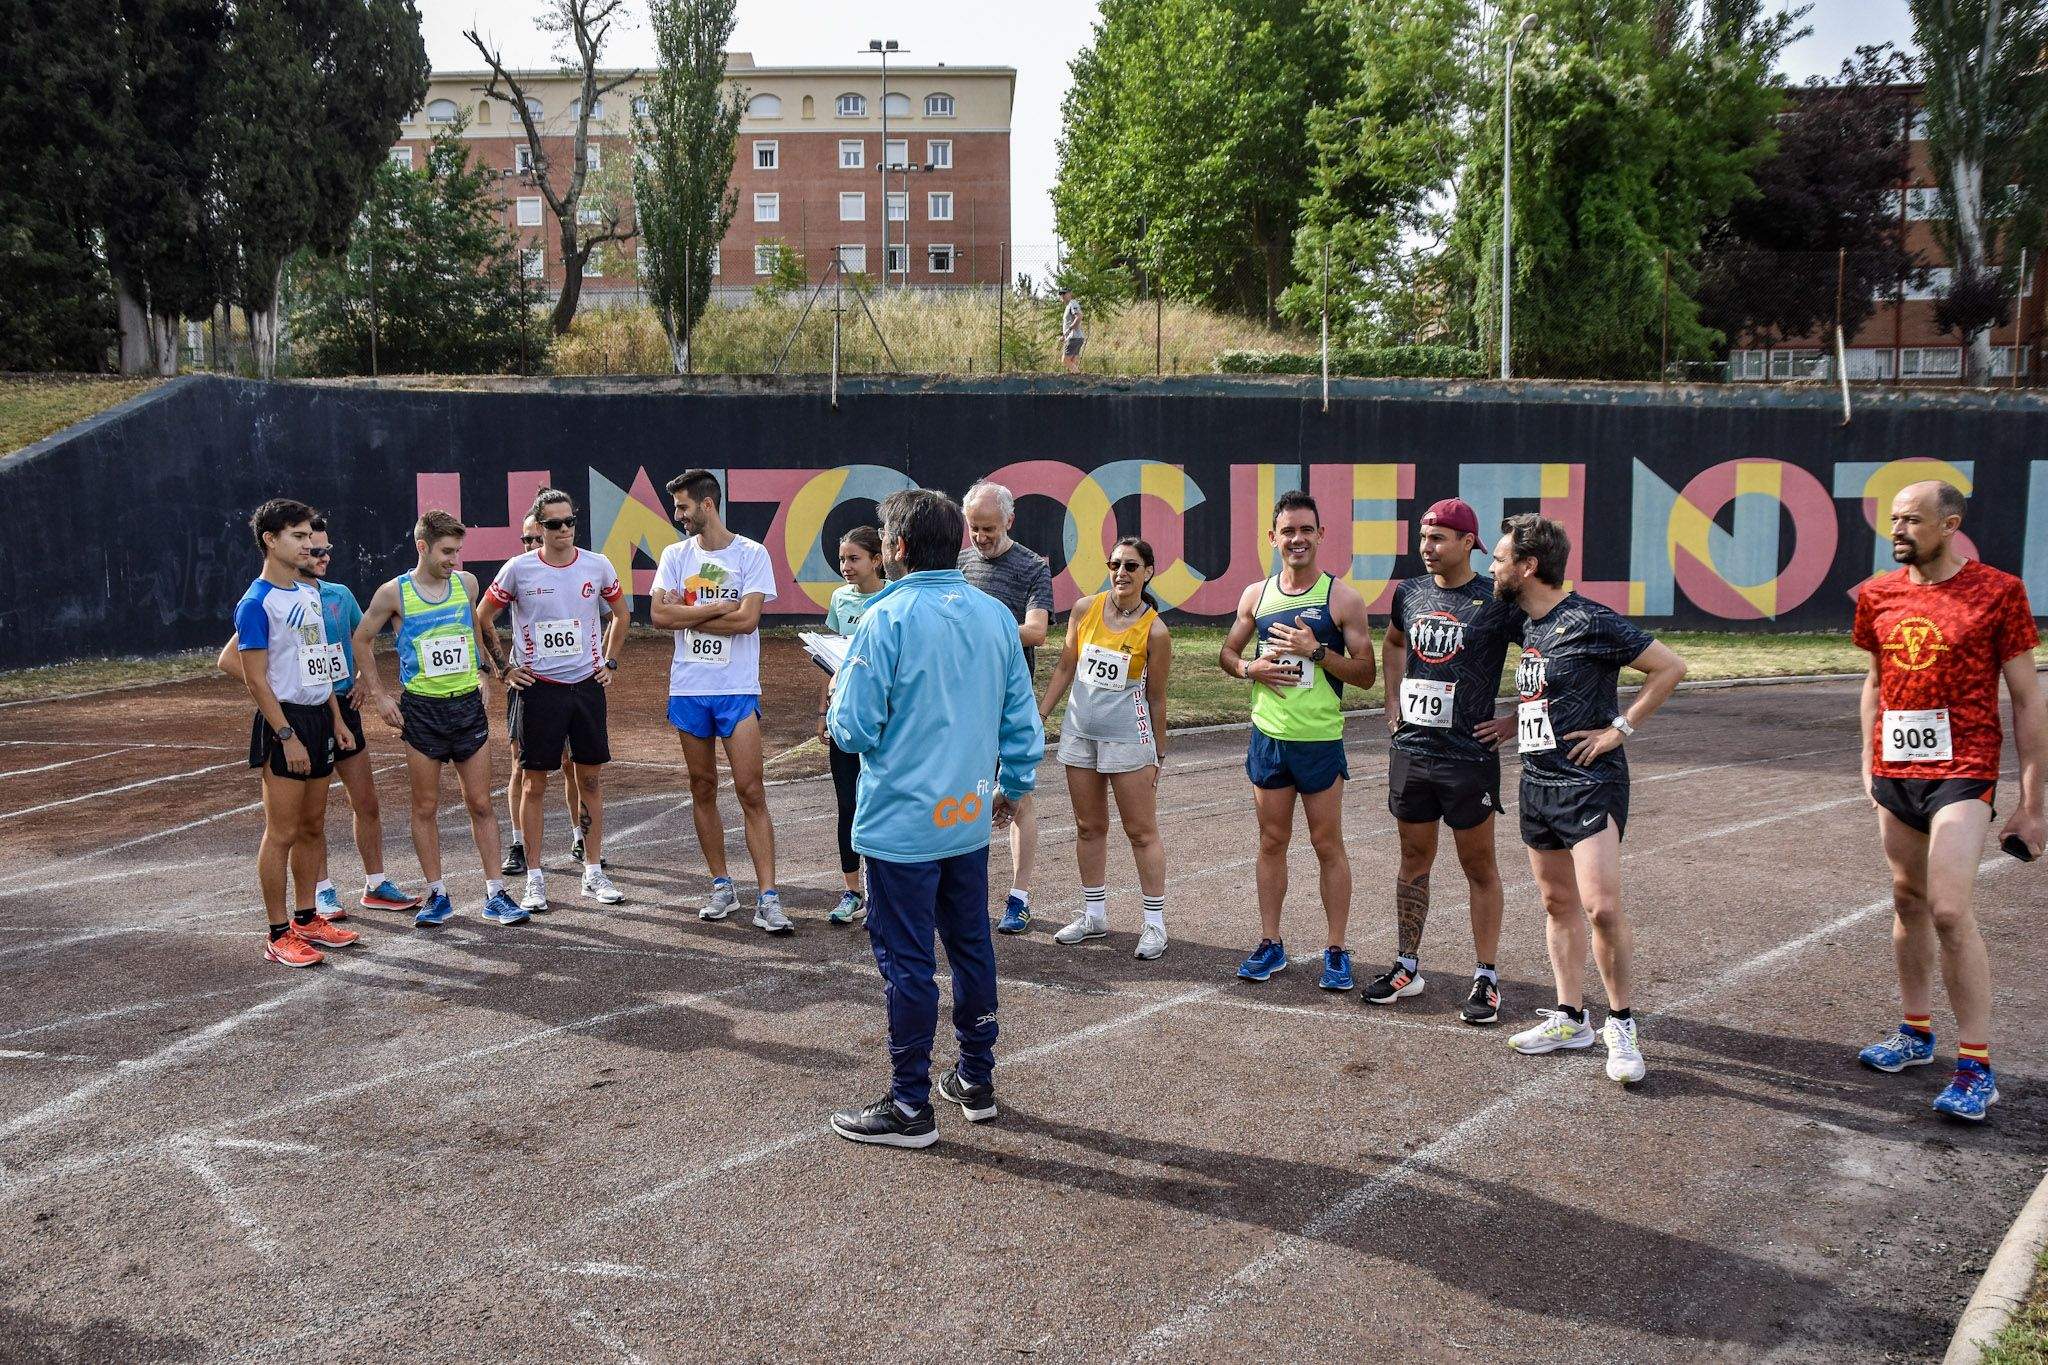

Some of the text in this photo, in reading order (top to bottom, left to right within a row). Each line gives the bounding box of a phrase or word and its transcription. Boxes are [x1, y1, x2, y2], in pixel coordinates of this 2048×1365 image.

[700, 586, 739, 599] Ibiza
[544, 631, 575, 648] 866
[692, 638, 722, 655] 869
[432, 648, 462, 667] 867
[1088, 657, 1119, 681] 759
[1408, 693, 1442, 717] 719
[1893, 728, 1938, 749] 908
[932, 791, 982, 829] GO
